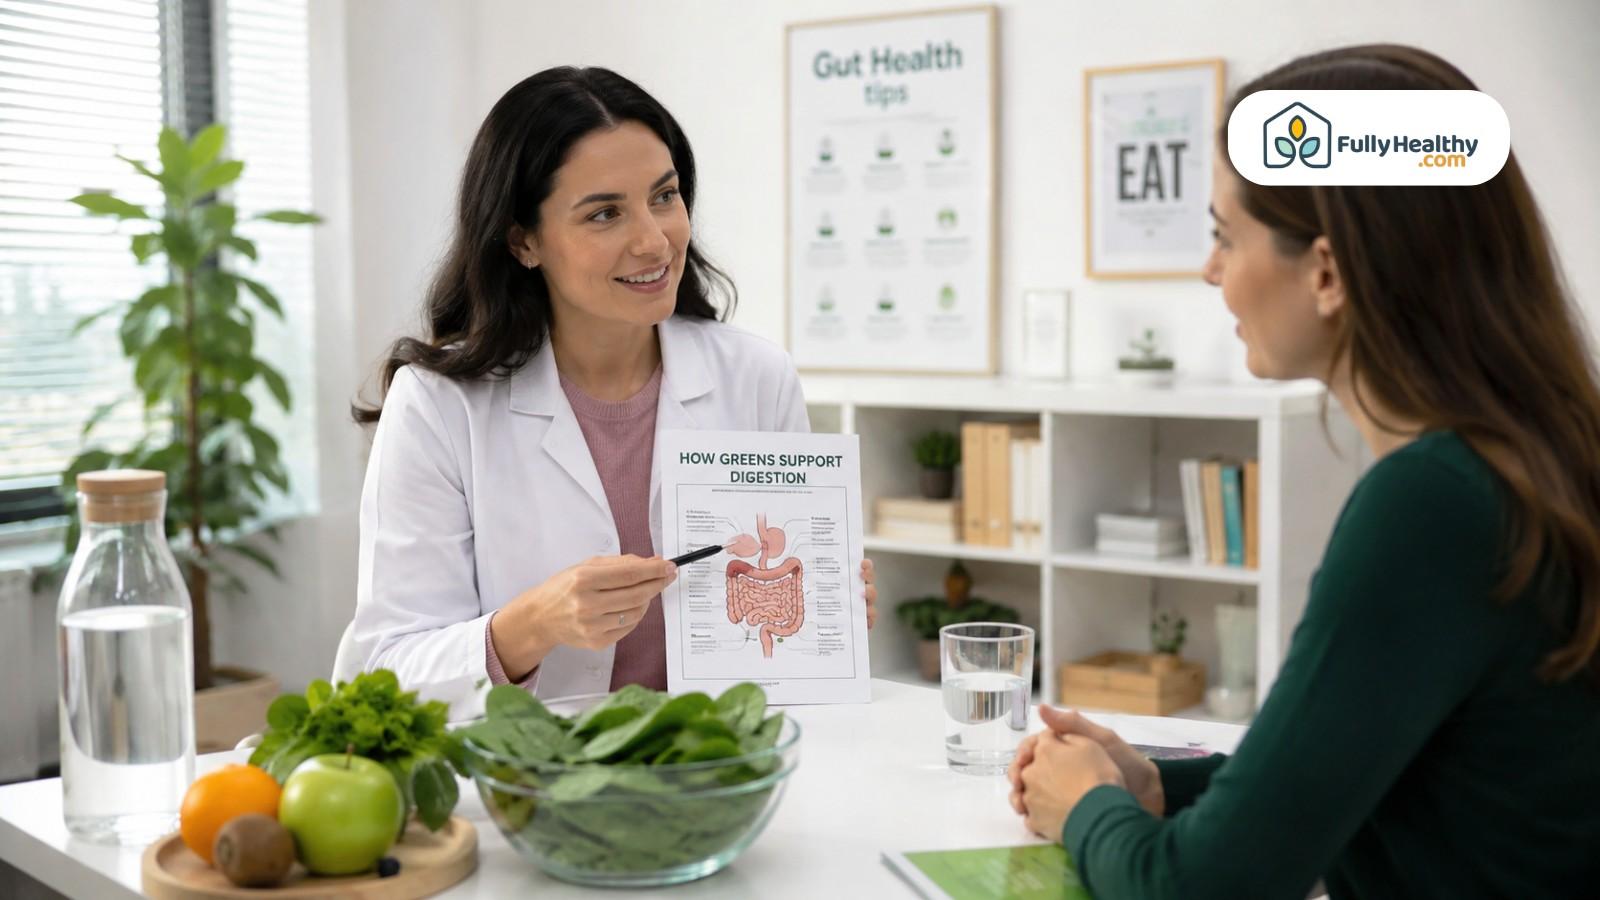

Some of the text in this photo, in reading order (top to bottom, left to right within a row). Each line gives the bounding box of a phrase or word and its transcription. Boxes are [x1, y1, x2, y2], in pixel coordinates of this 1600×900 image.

[813, 41, 963, 79] Gut Health
[864, 82, 909, 109] tips
[1117, 140, 1189, 203] EAT
[679, 452, 843, 468] HOW GREENS SUPPORT
[730, 470, 807, 484] DIGESTION
